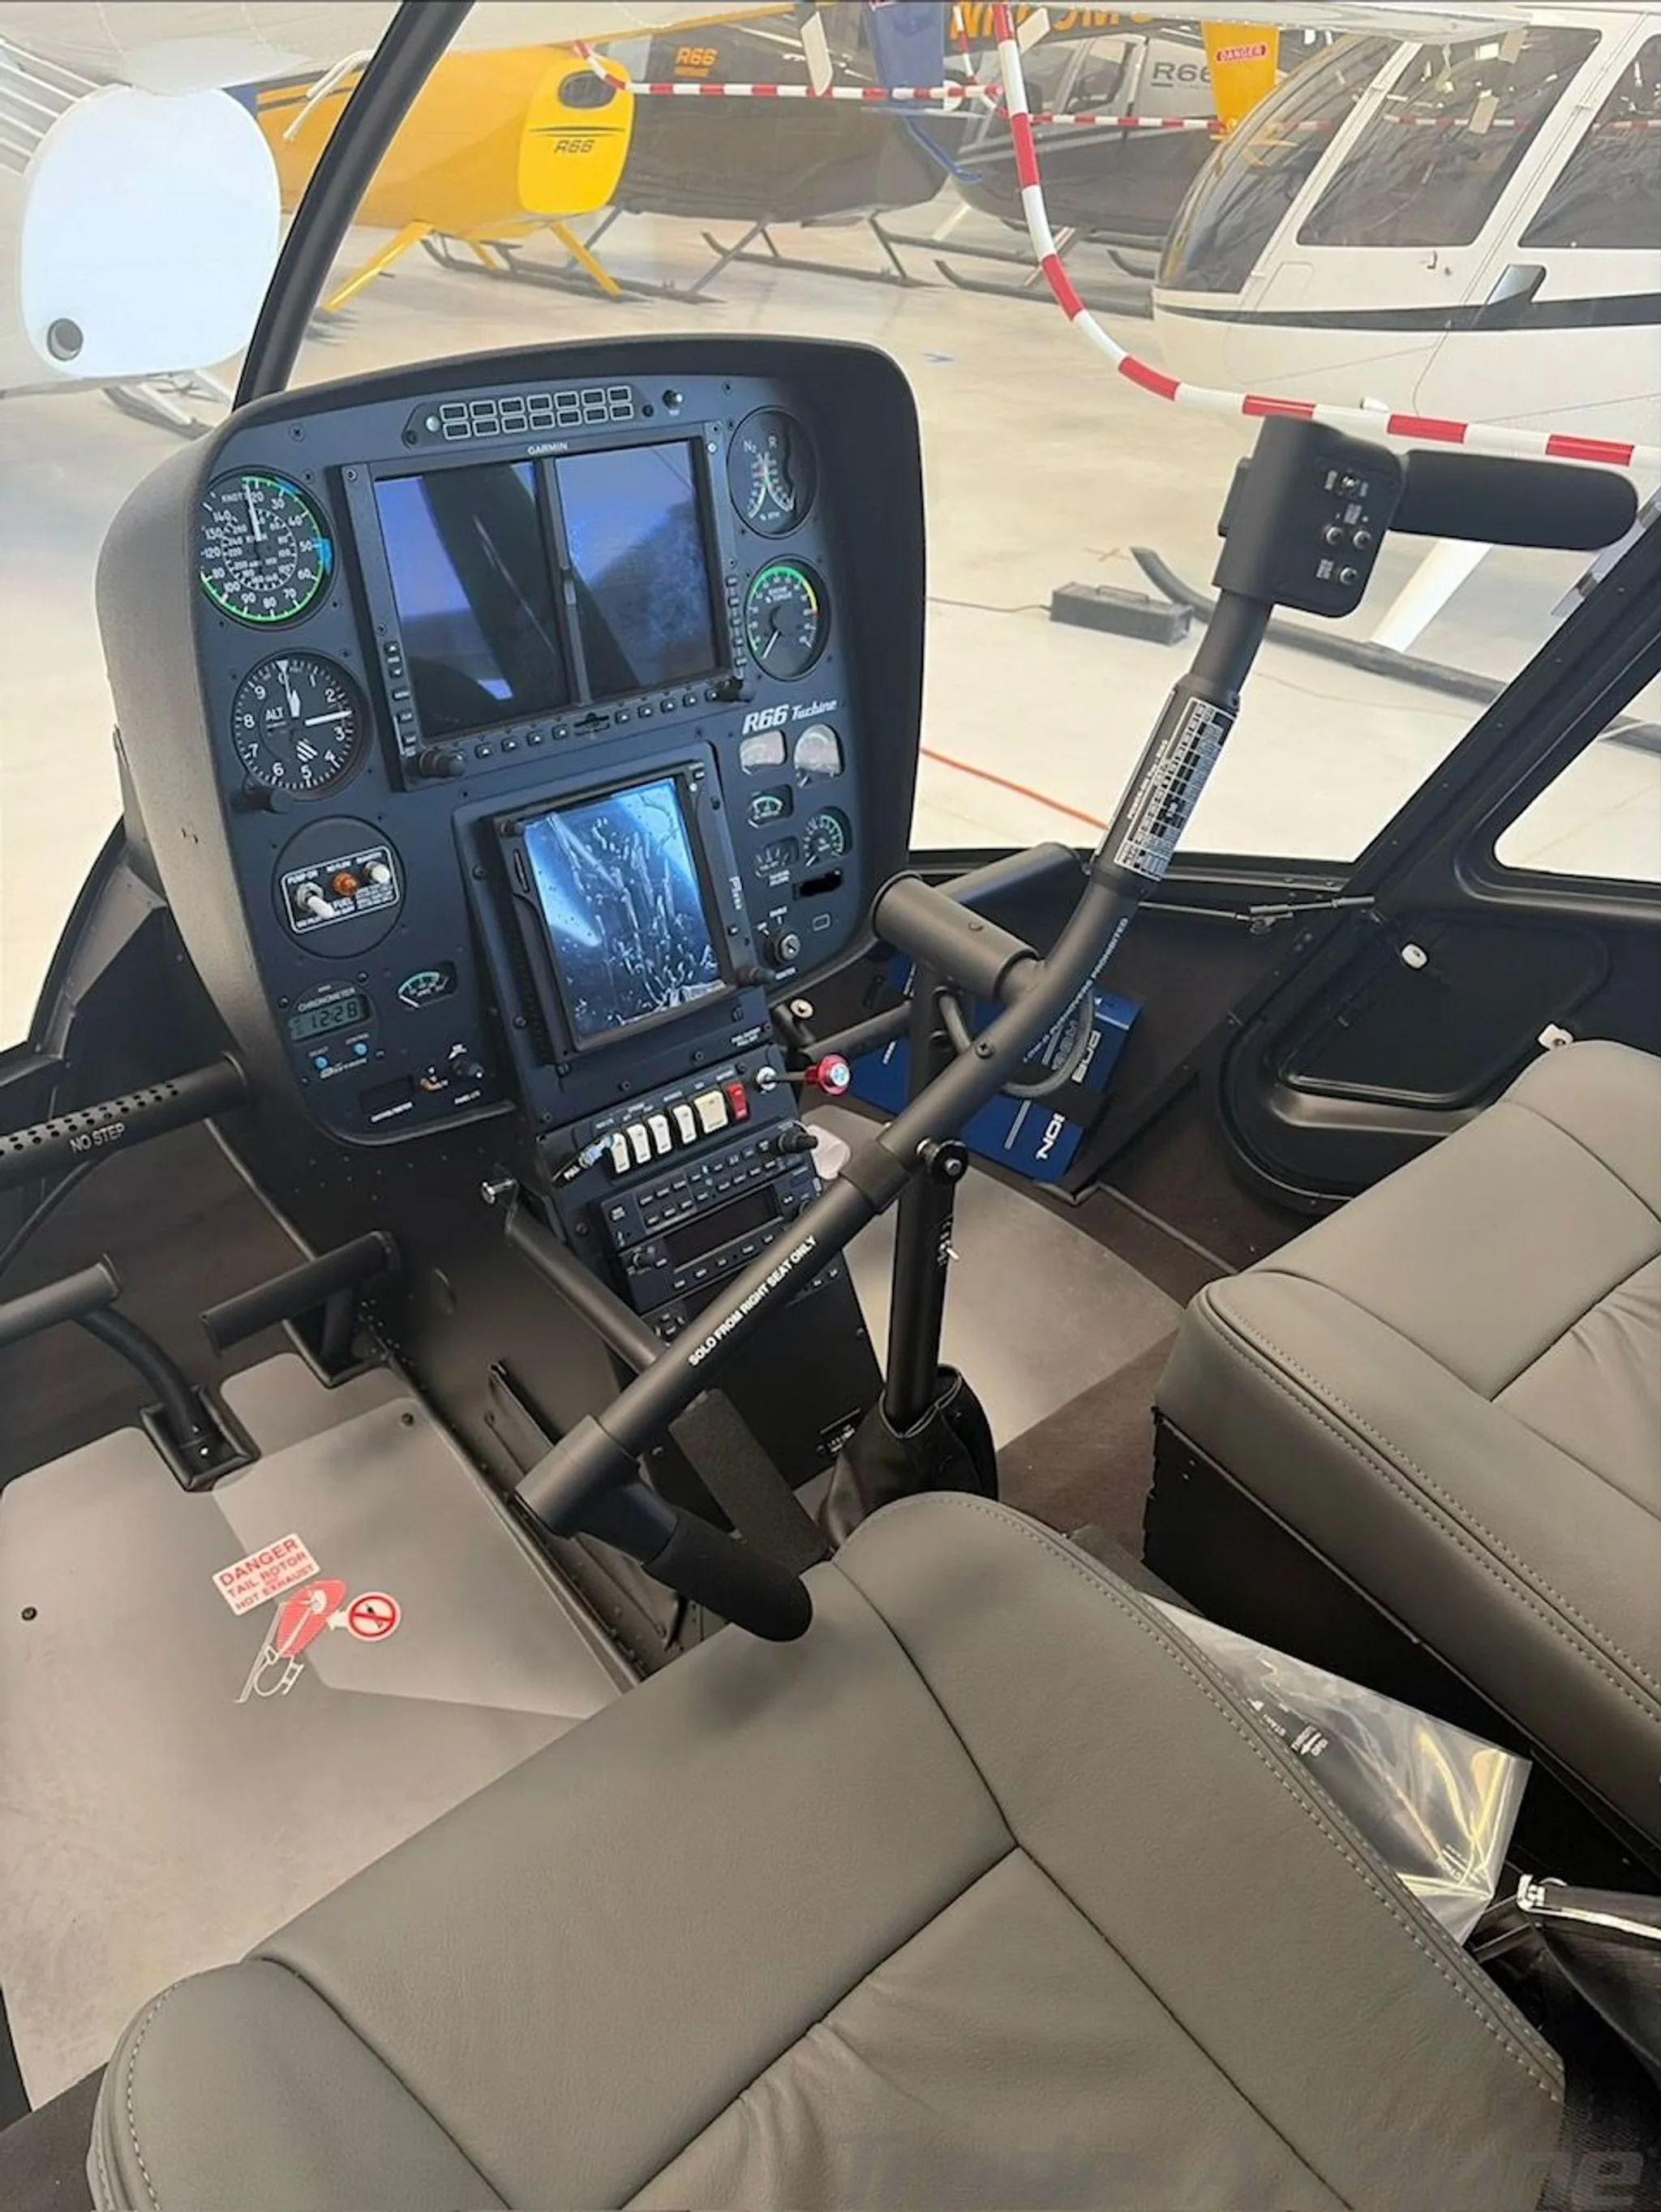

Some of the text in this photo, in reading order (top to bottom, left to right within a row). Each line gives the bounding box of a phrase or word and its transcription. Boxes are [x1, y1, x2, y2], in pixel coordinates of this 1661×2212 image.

[675, 46, 719, 66] R66
[553, 139, 595, 154] R66
[527, 442, 569, 455] GARMIN
[271, 498, 285, 510] 30
[299, 540, 312, 552] 50
[240, 592, 256, 603] 90
[282, 588, 297, 599] 70
[263, 598, 277, 609] 80
[254, 687, 266, 700] 9
[325, 688, 337, 703] 2
[265, 706, 284, 720] ALT
[741, 704, 789, 735] R66
[243, 714, 255, 729] 8
[334, 727, 346, 741] 3
[248, 744, 260, 757] 7
[272, 762, 285, 777] 6
[301, 765, 312, 779] 5
[297, 987, 356, 1013] CHRONOMETER
[69, 1122, 125, 1154] NO STEP
[688, 1234, 818, 1367] SOLO FROM RIGHT SEAT ONLY
[219, 1537, 299, 1587] DANGER
[227, 1551, 307, 1599] TAIL ROTOR
[235, 1563, 315, 1611] HOT EXHAUST
